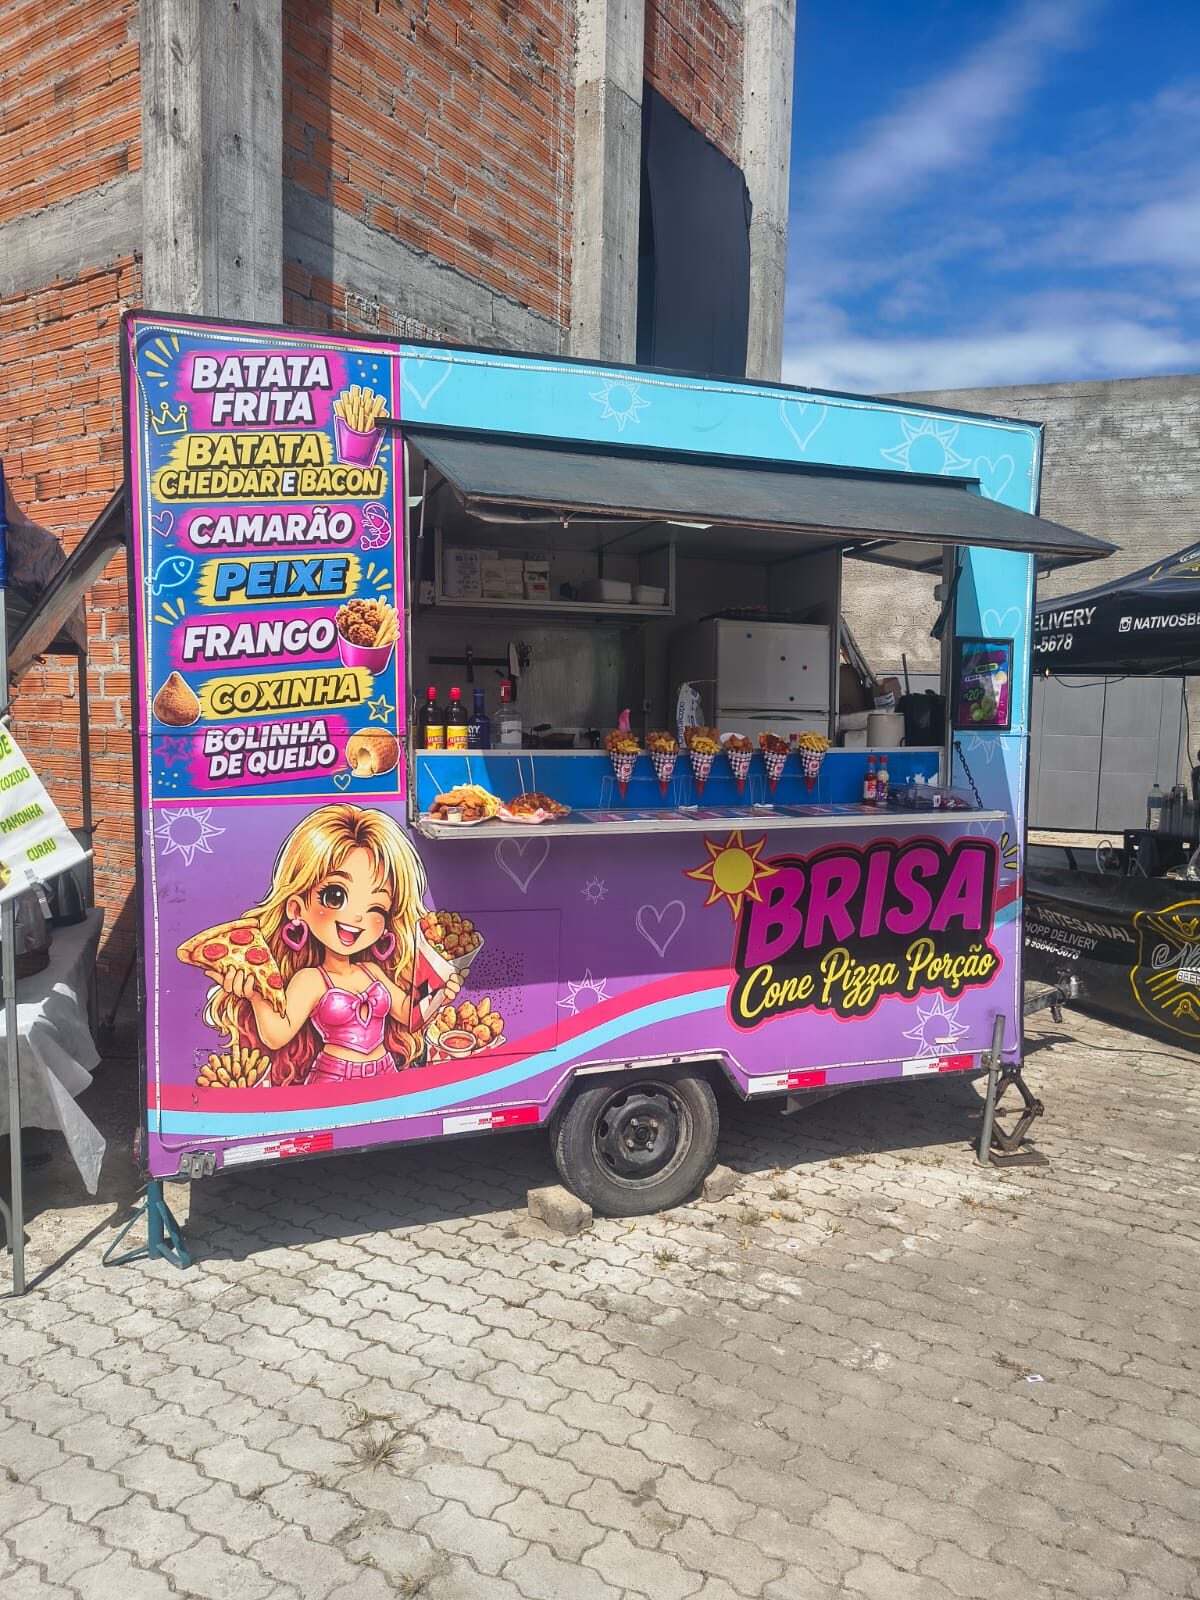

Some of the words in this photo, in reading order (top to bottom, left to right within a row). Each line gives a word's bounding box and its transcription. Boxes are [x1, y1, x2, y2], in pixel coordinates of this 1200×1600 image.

[191, 355, 330, 391] BATATA
[211, 391, 315, 425] FRITA
[187, 434, 323, 468] BATATA
[159, 471, 278, 498] CHEDDAR
[282, 471, 298, 495] E
[300, 468, 381, 494] BACON
[189, 507, 353, 546] CAMARÃO
[214, 558, 349, 600] PEIXE
[183, 619, 335, 661] FRANGO
[210, 674, 359, 714] COXINHA
[204, 720, 328, 755] BOLINHA
[0, 766, 30, 791] COZIDO
[208, 753, 244, 779] DE
[247, 744, 335, 775] QUEIJO
[0, 803, 44, 834] PAMONHA
[26, 837, 57, 862] CURAU
[744, 849, 987, 969] BRISA
[1050, 929, 1098, 951] DELIVERY
[739, 964, 815, 1019] Cone
[820, 946, 900, 1010] Pizza
[905, 937, 996, 990] Porção
